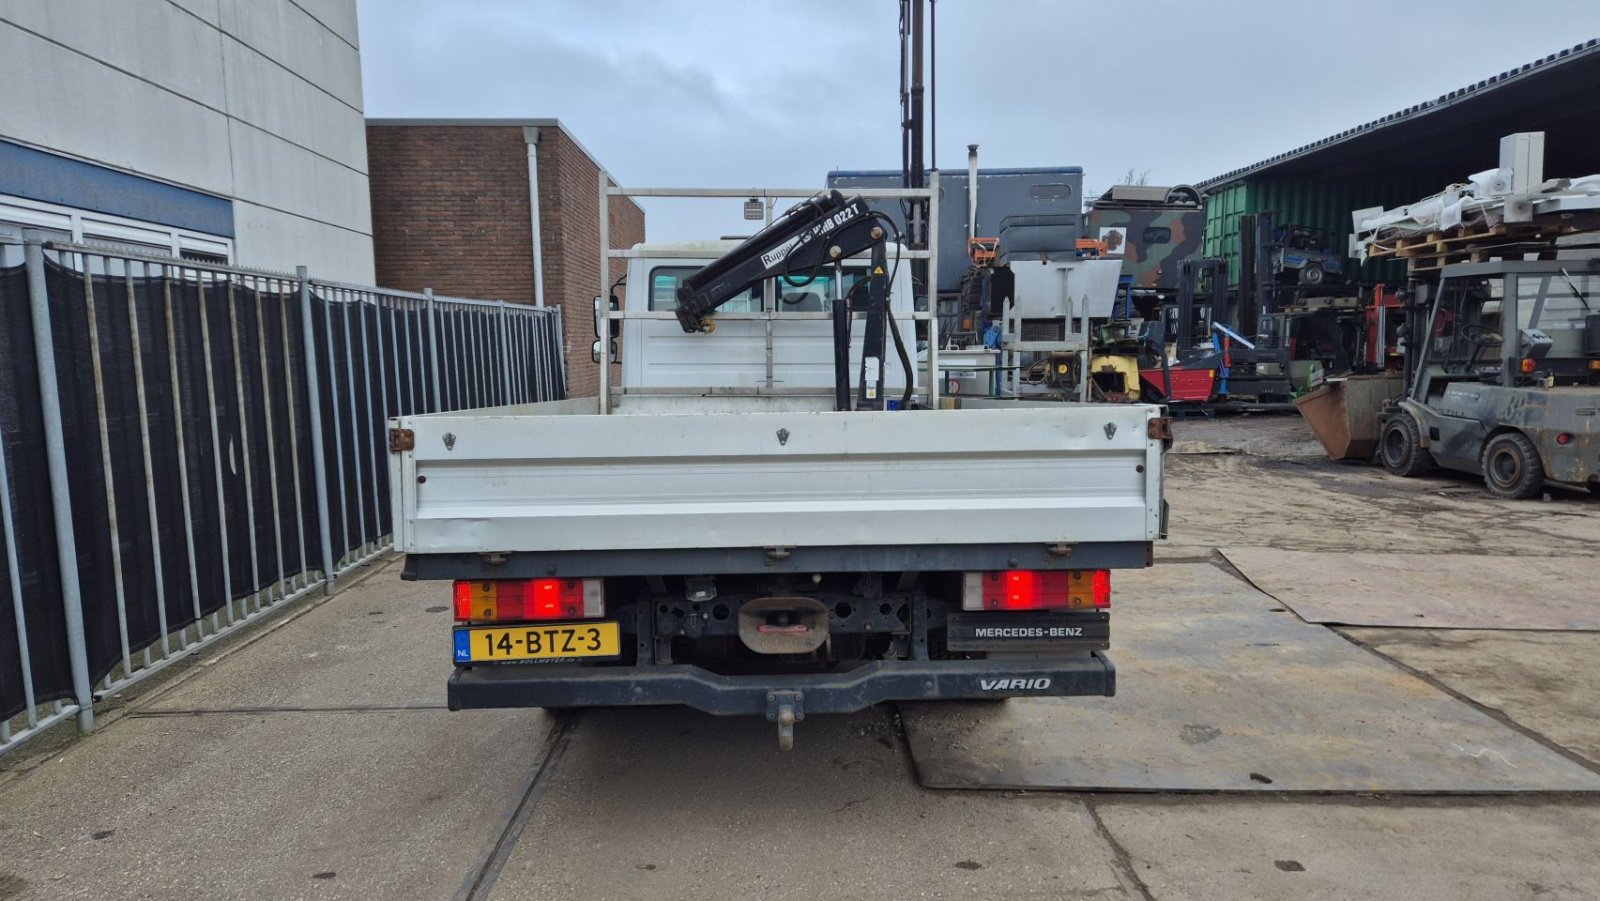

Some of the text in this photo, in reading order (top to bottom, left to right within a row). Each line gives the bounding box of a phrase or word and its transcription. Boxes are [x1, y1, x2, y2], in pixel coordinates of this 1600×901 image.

[975, 627, 1083, 638] MERCEDES-BENZ
[485, 627, 602, 656] 14-BTZ-3
[980, 678, 1051, 690] VARIO
